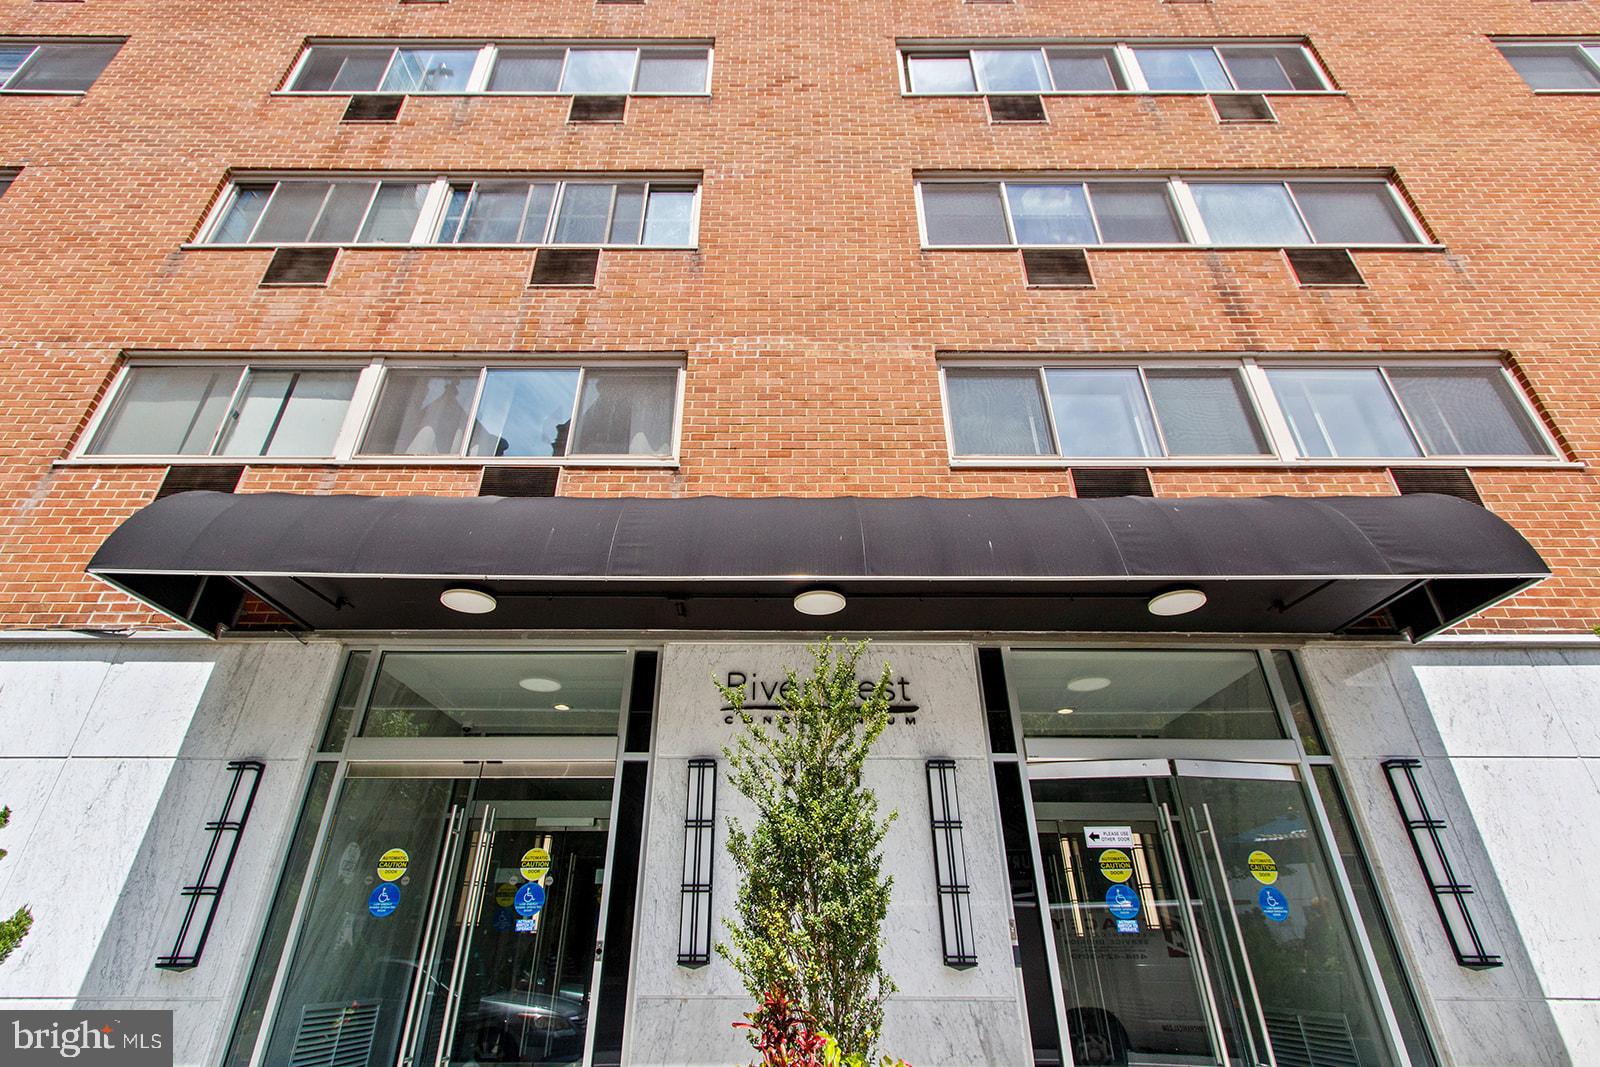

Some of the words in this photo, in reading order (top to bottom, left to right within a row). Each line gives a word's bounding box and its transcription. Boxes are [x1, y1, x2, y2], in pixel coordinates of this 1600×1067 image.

[379, 861, 407, 869] CAUTION
[521, 861, 550, 869] CAUTION
[1099, 861, 1132, 869] CAUTION
